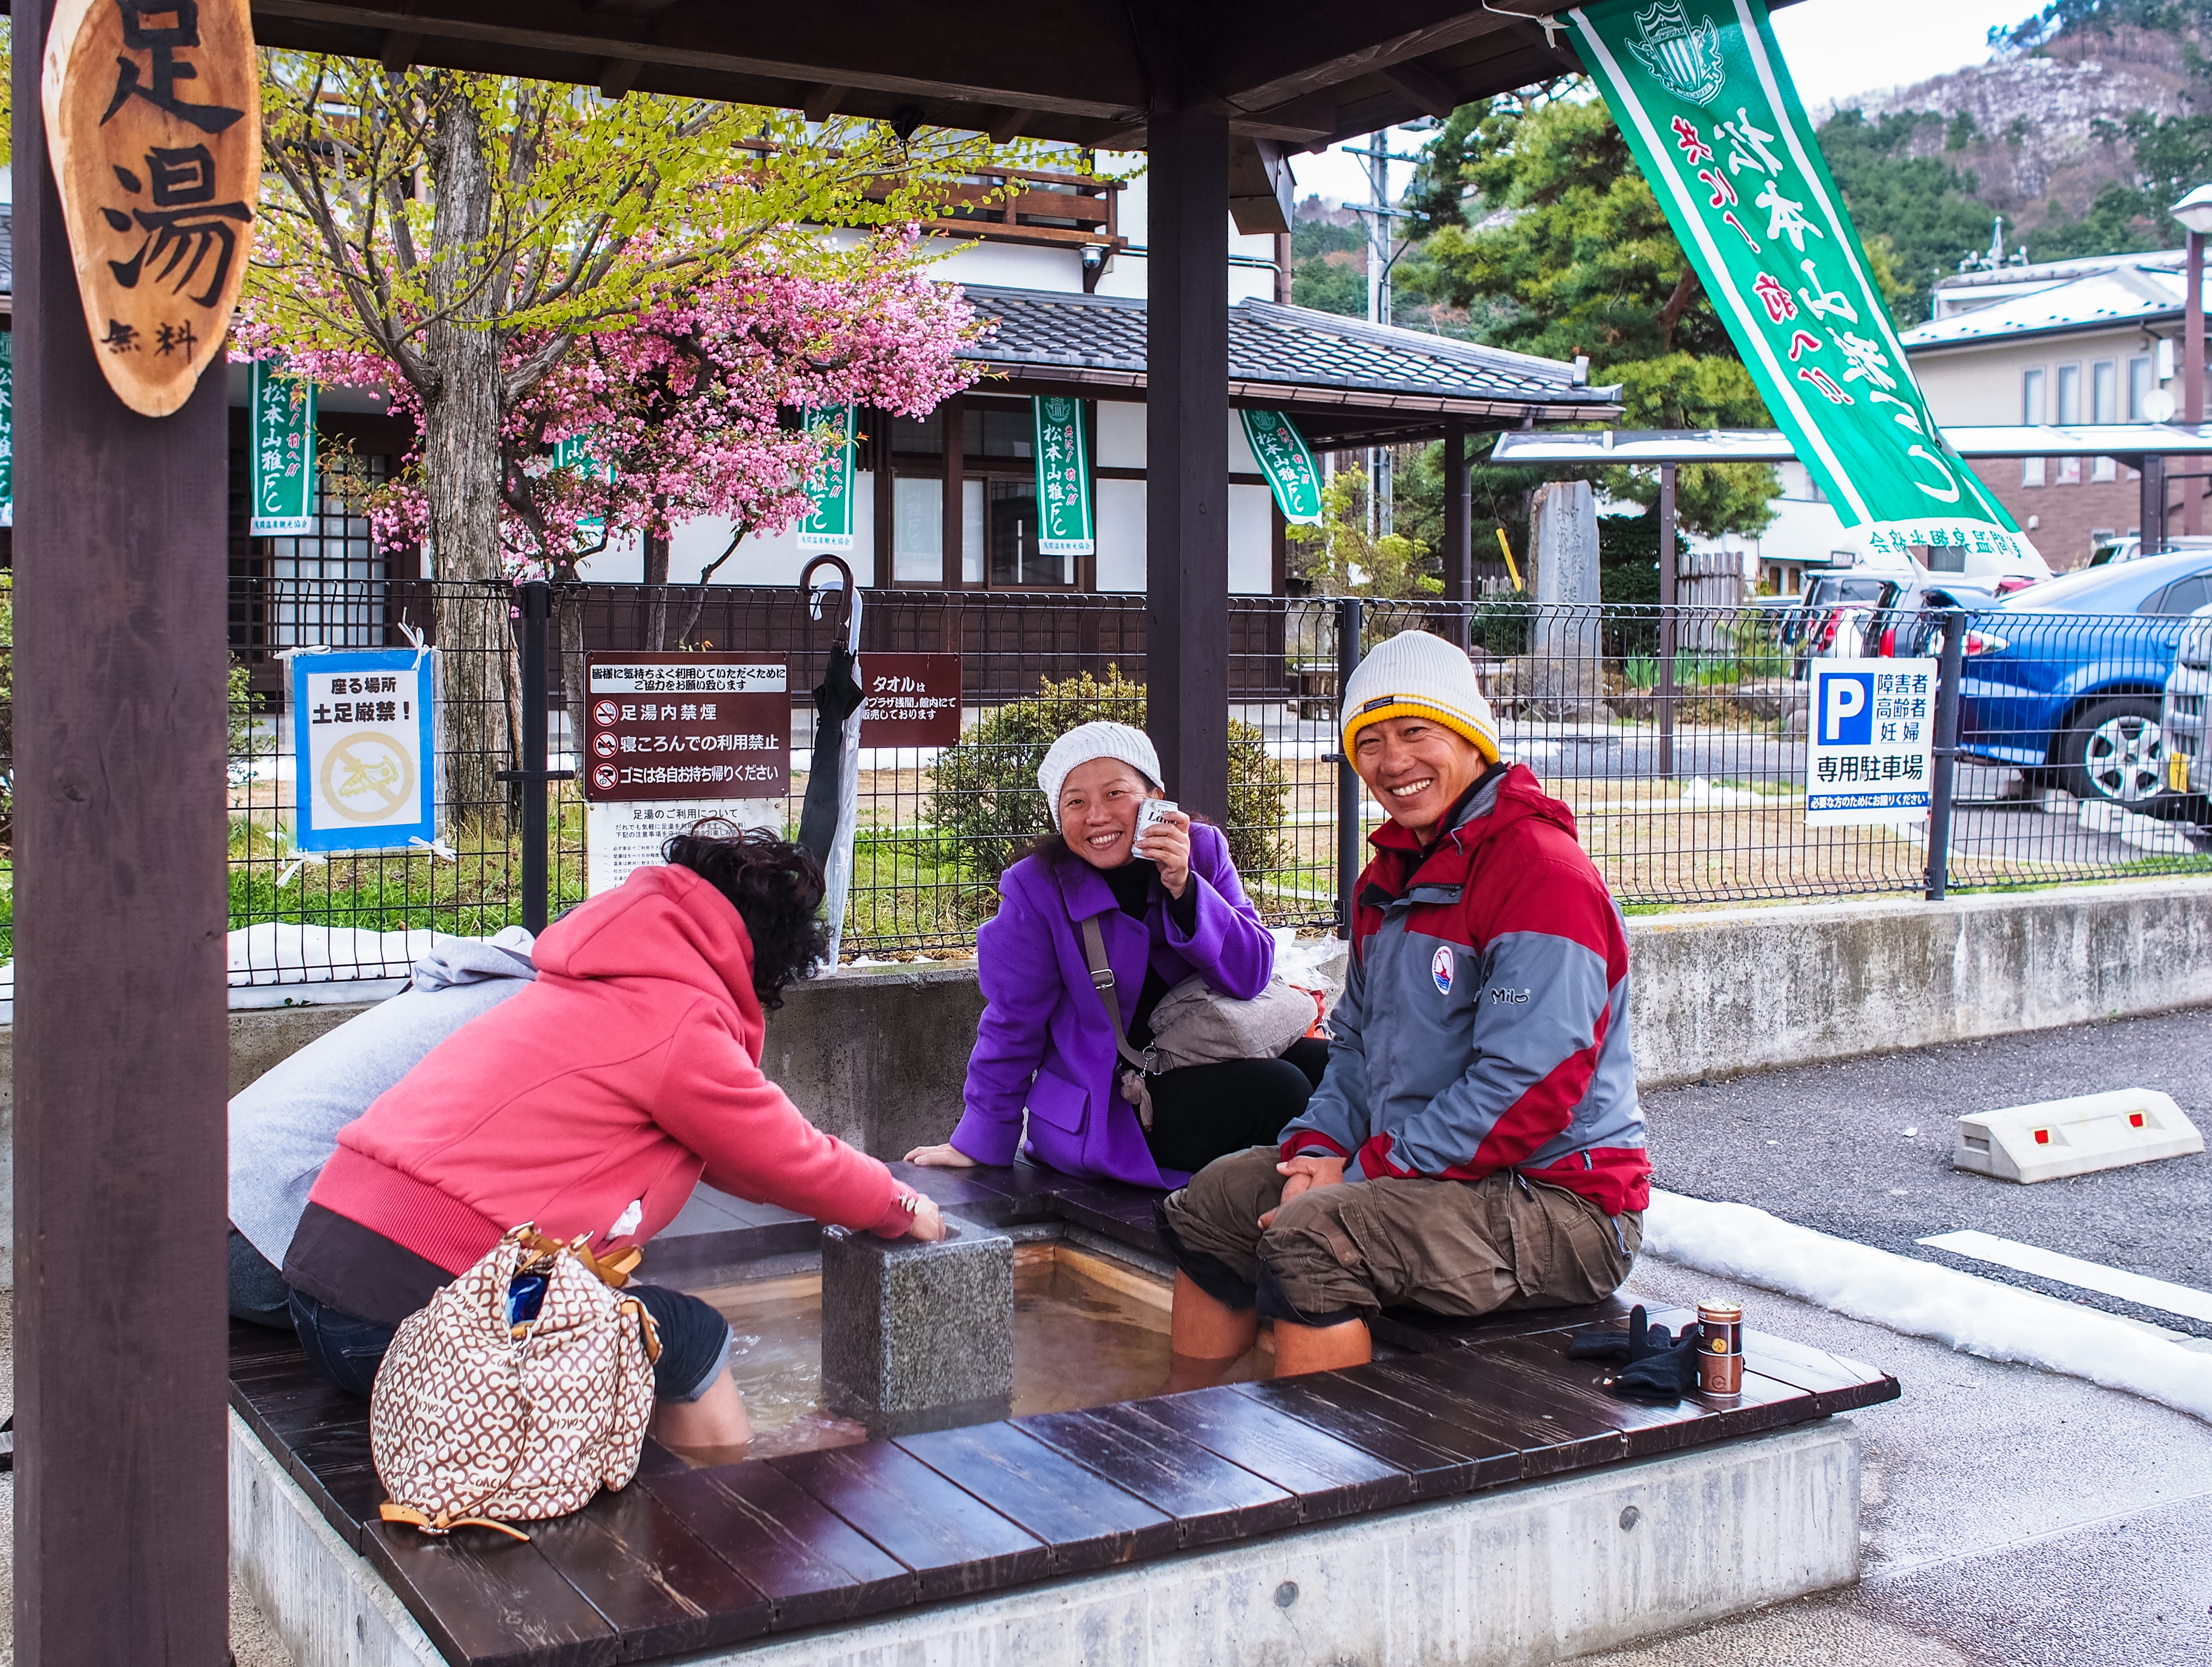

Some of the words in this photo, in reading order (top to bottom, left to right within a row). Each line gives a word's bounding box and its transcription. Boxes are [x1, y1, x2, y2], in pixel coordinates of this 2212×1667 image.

[100, 0, 253, 308] 足湯
[100, 319, 198, 364] 無料
[261, 381, 286, 513] 松本山雅FC
[1043, 424, 1067, 536] 松本山雅FC
[1256, 432, 1304, 513] 松本山雅FC
[253, 520, 307, 529] 浅間温泉観光協会
[592, 668, 786, 680] 皆様に気持ちよく利用していただくために
[331, 676, 397, 695] 座る場所
[634, 680, 746, 692] ご協力をお願い致します
[873, 676, 926, 693] タオルは
[1877, 674, 1928, 695] 障害者
[620, 704, 717, 722] 足湯内禁煙
[862, 709, 936, 721] 販売しております
[1826, 678, 1866, 740] P
[1876, 698, 1926, 719] 高齢者
[1880, 722, 1919, 742] 妊婦
[620, 734, 780, 753] 寝ころんでの利用禁止
[620, 764, 778, 784] ゴミは各自お持ち帰りください
[1817, 754, 1923, 783] 専用駐車場
[1810, 795, 1926, 809] 必要な方のためにお譲りください
[633, 808, 738, 820] 足湯のご利用について
[1490, 987, 1529, 1005] Milo
